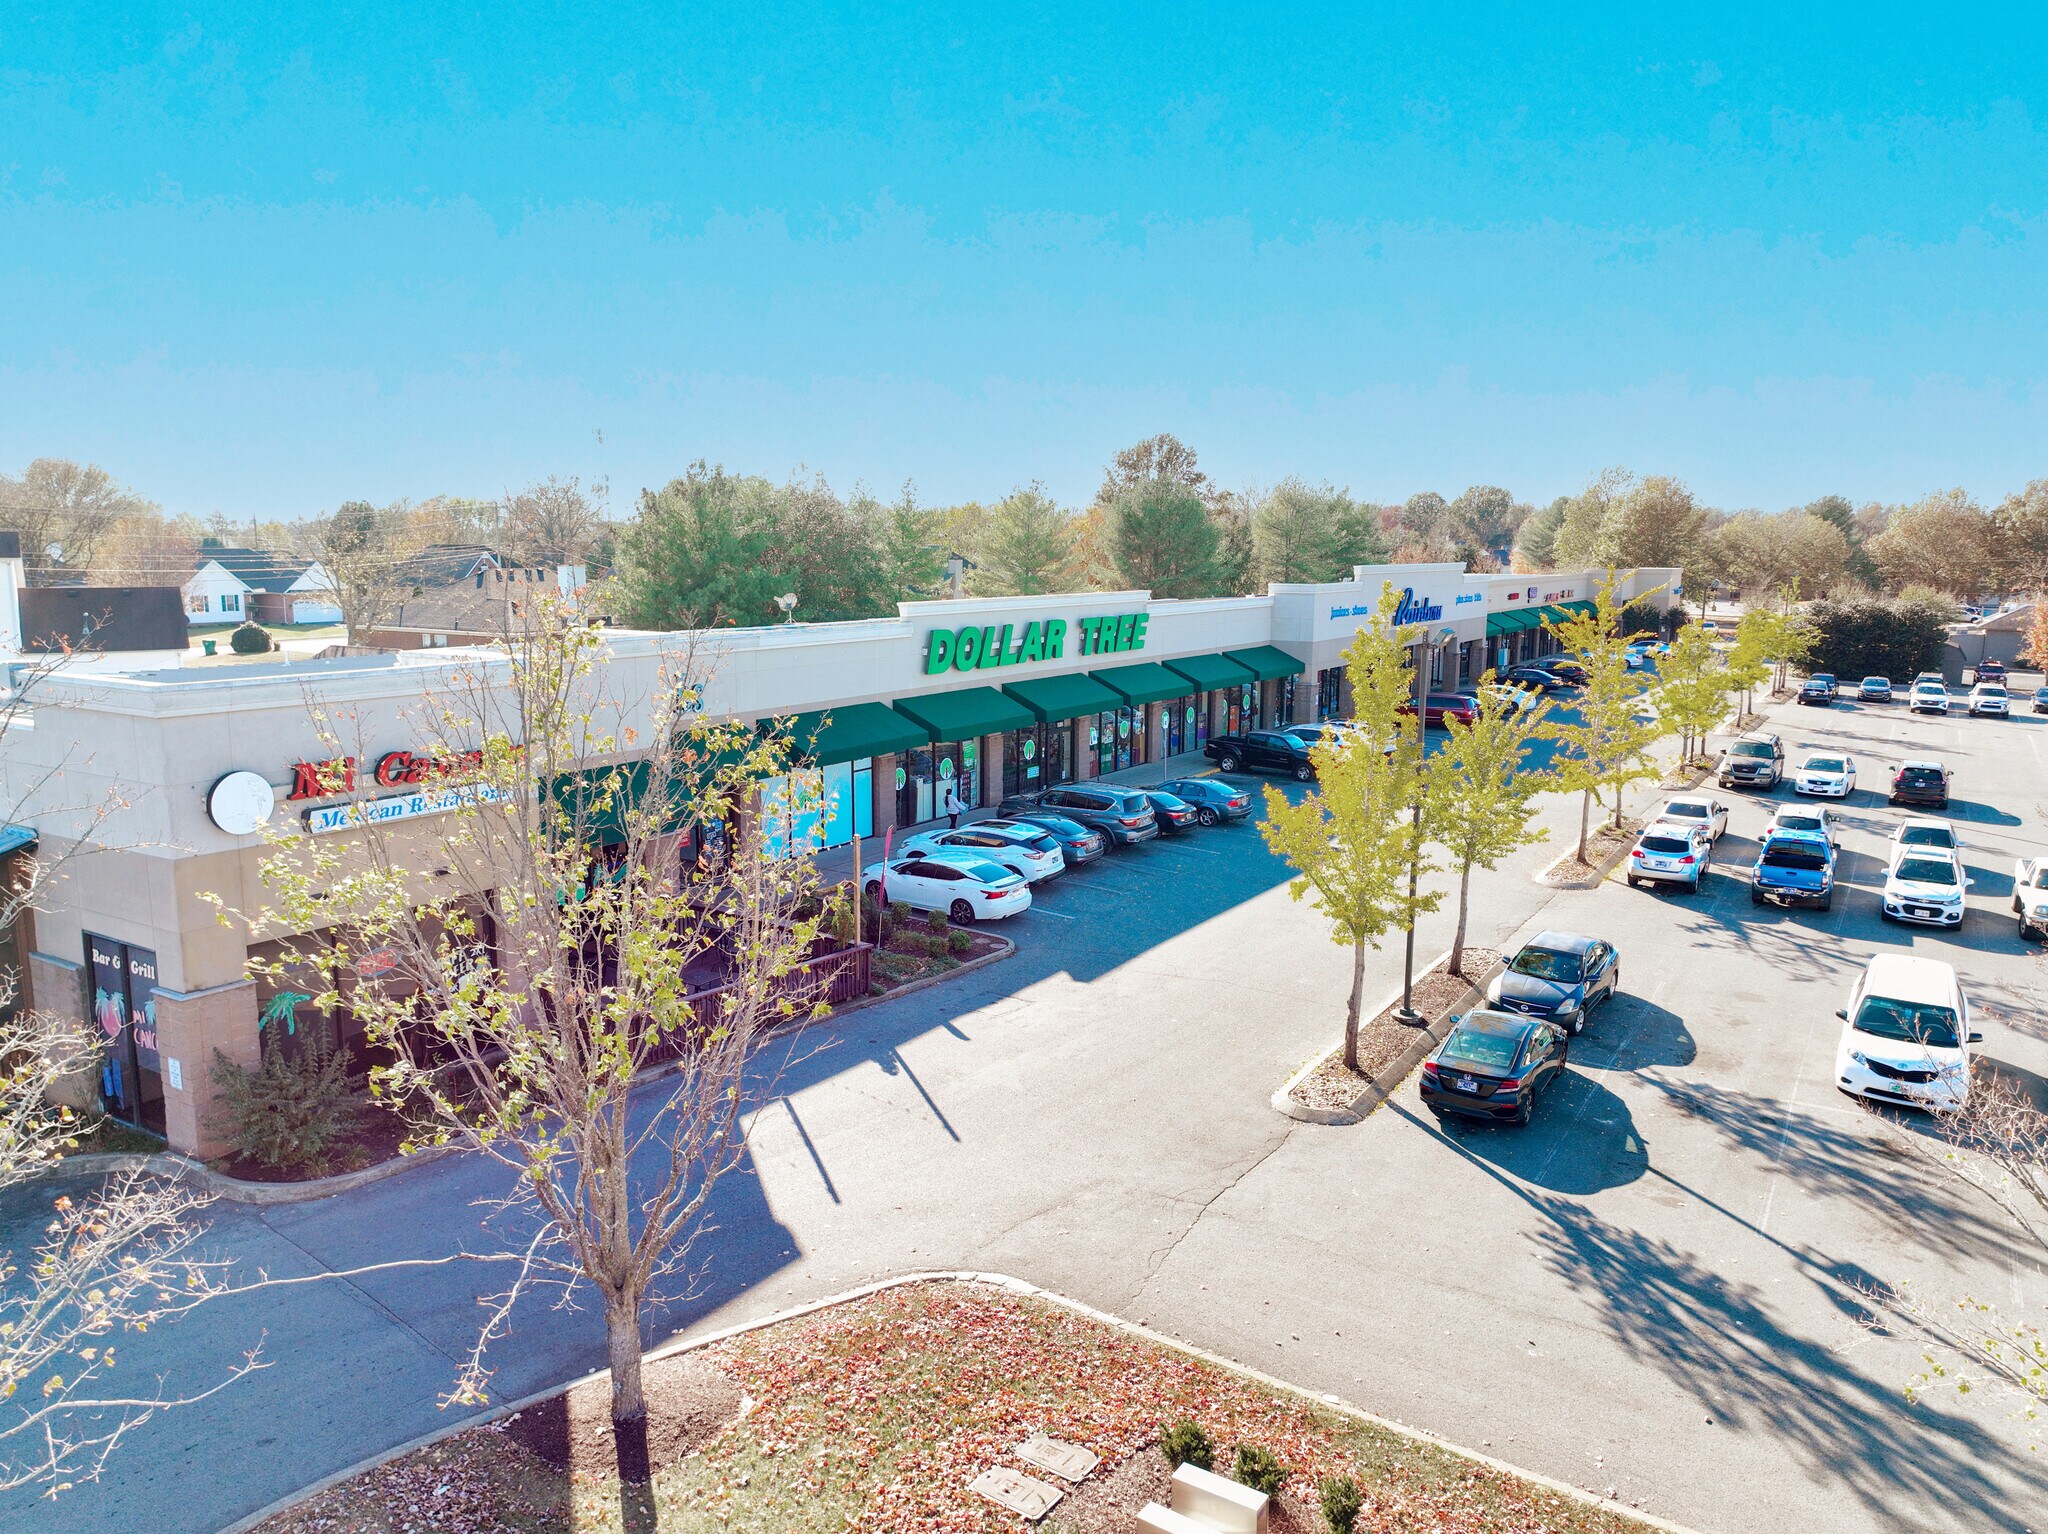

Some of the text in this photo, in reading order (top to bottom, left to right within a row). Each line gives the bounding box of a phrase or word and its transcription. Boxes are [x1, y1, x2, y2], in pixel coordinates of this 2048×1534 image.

[1331, 604, 1368, 620] juniors shoes
[1394, 587, 1443, 626] Rainbow
[925, 612, 1150, 675] DOLLAR TREE
[319, 803, 402, 829] Mecan
[92, 948, 156, 979] Bar & Grill
[132, 1009, 146, 1024] MI
[133, 1028, 158, 1050] CANC
